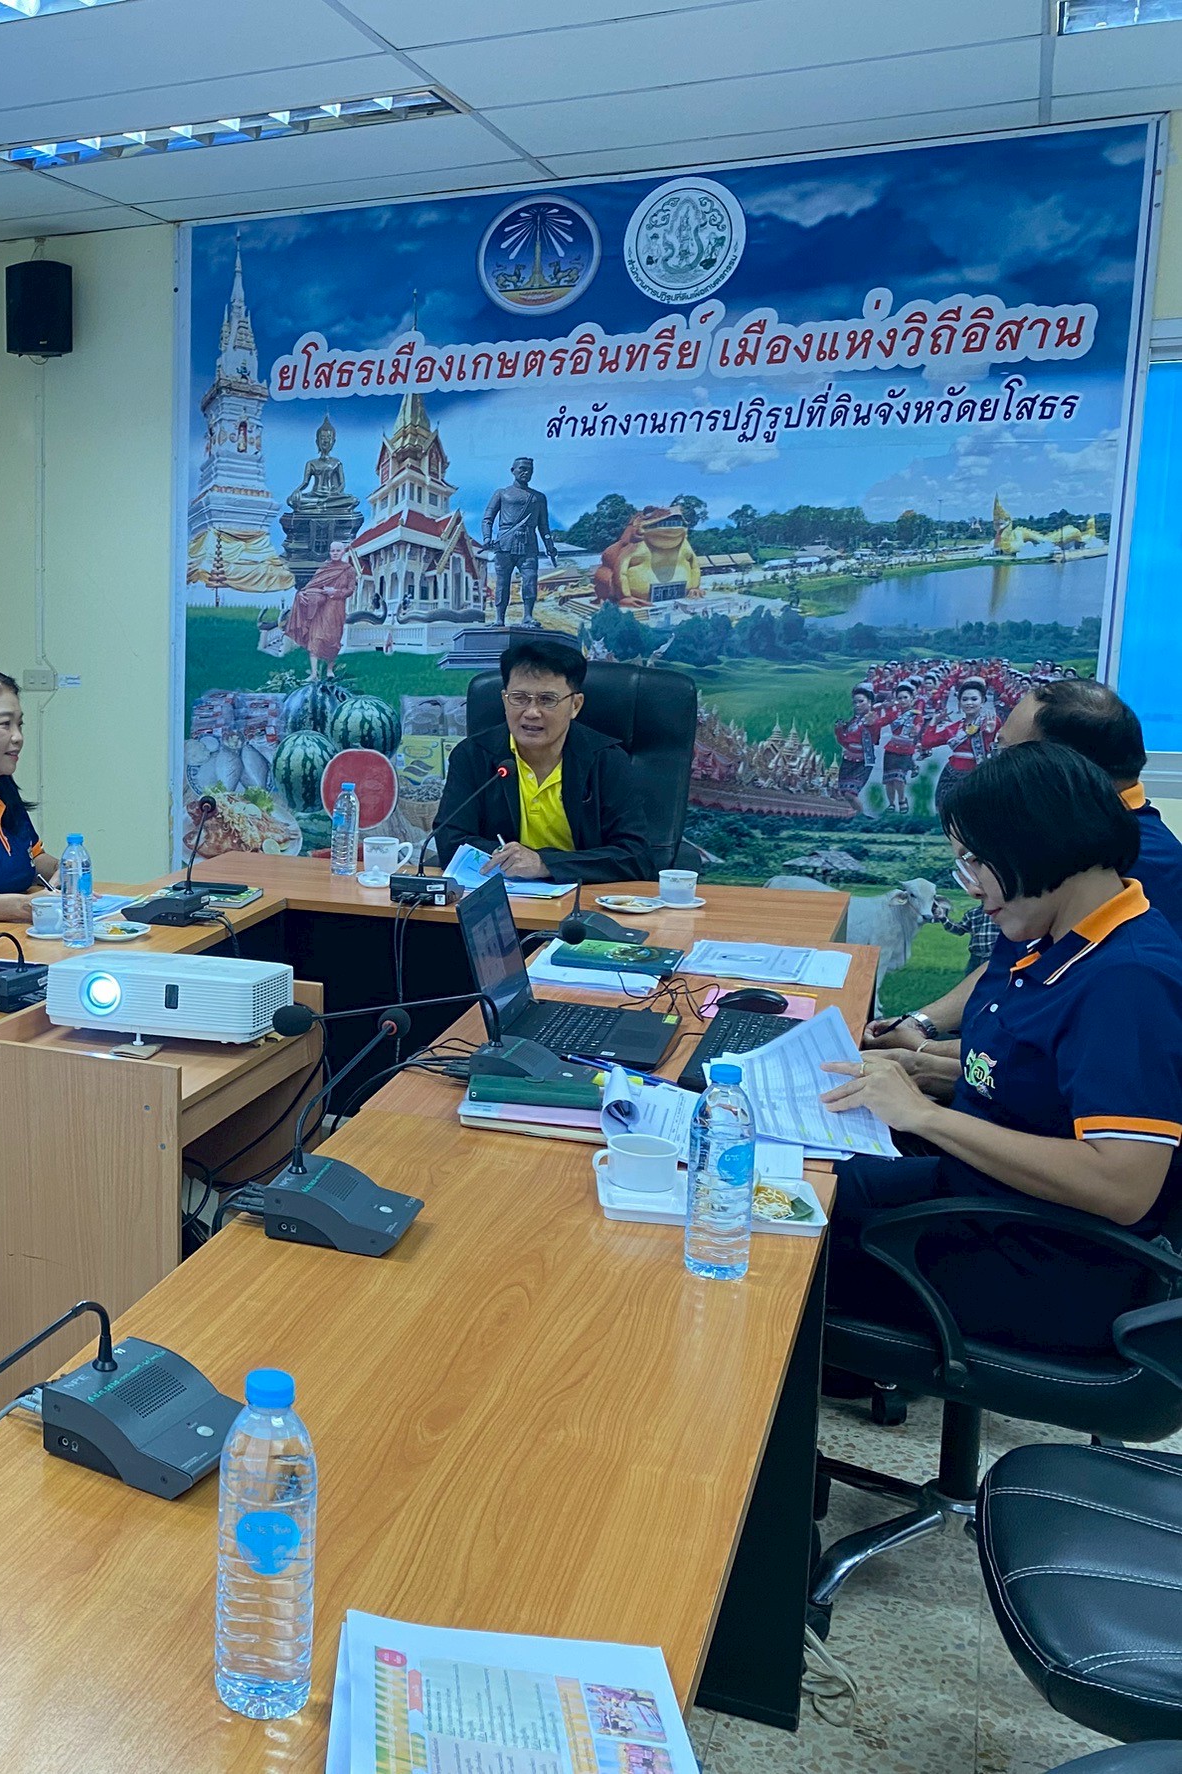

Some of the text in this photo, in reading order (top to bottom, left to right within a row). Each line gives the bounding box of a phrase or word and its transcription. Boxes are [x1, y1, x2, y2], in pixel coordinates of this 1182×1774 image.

[277, 298, 1086, 392] ยโสธรเมืองเกษตรอินทรีย์ เมืองแห่งวิถีอิสาน
[546, 377, 1080, 443] สำนักงานการปฏิรูปที่ดินจังหวัดยโสธร
